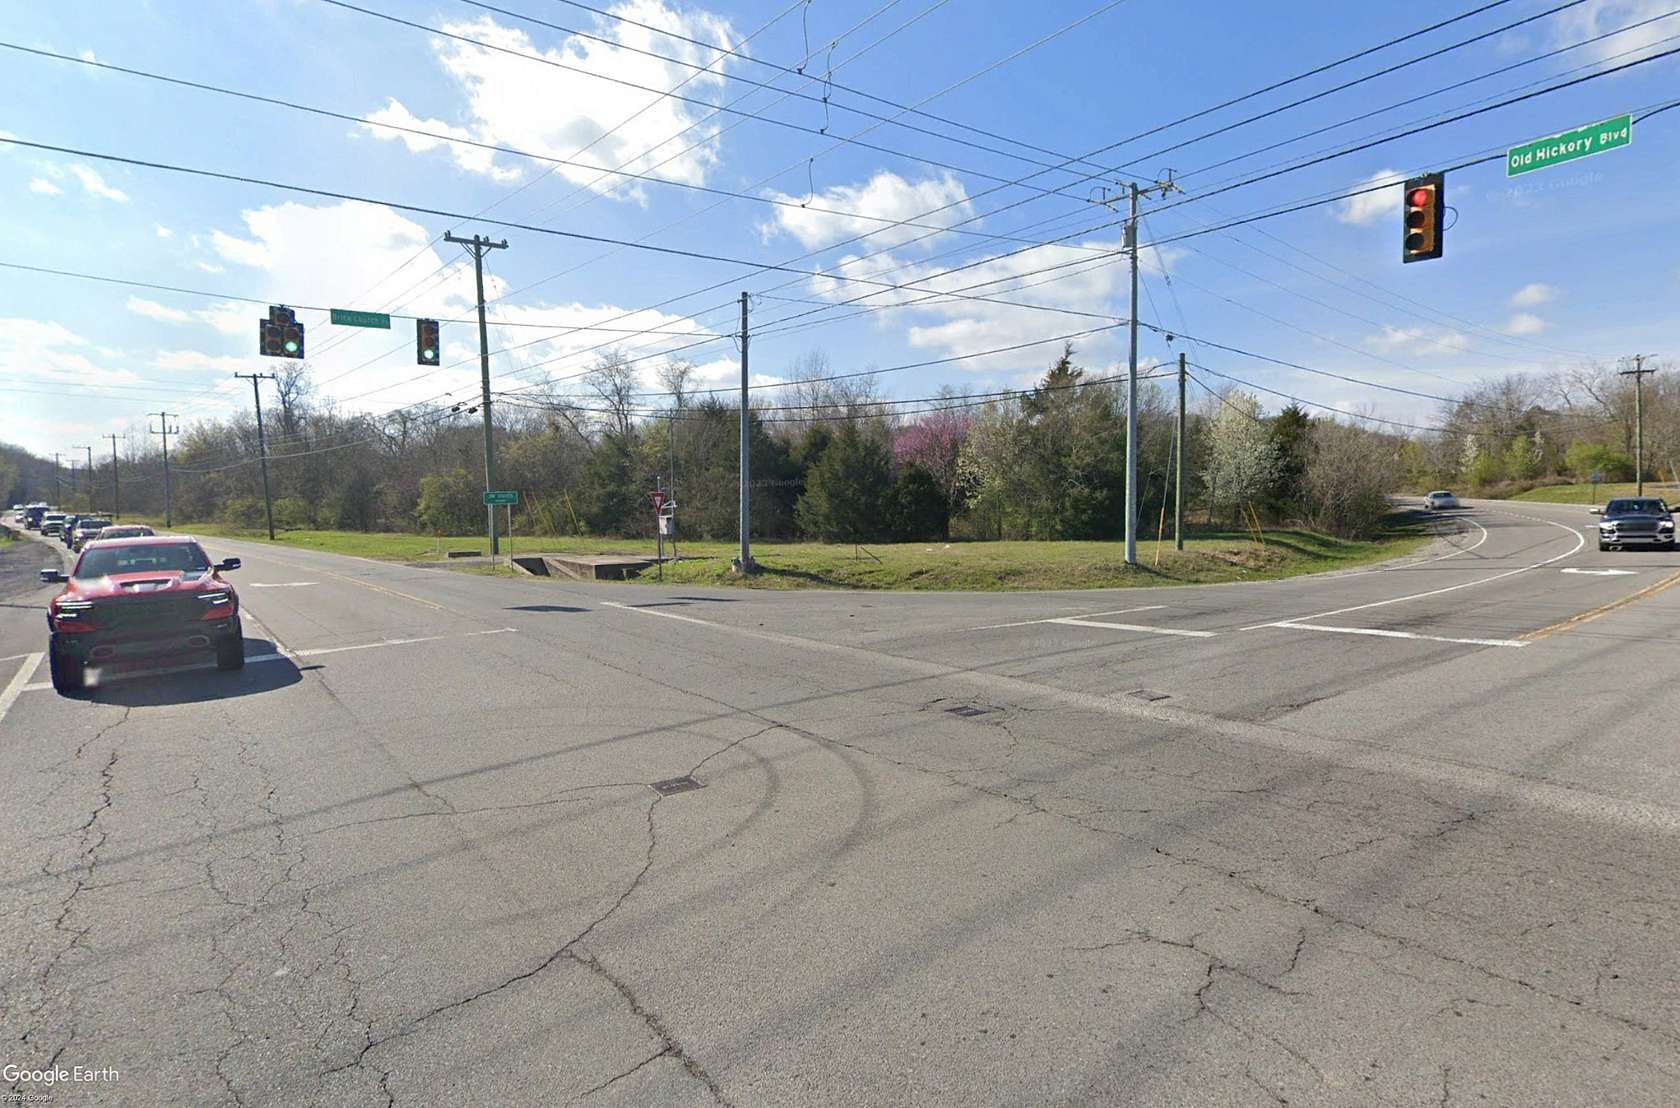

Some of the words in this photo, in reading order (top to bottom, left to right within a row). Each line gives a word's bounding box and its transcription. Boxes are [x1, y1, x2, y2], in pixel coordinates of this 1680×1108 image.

[1510, 152, 1532, 168] Old
[1536, 136, 1593, 161] Hickory
[1600, 127, 1628, 145] Blvd
